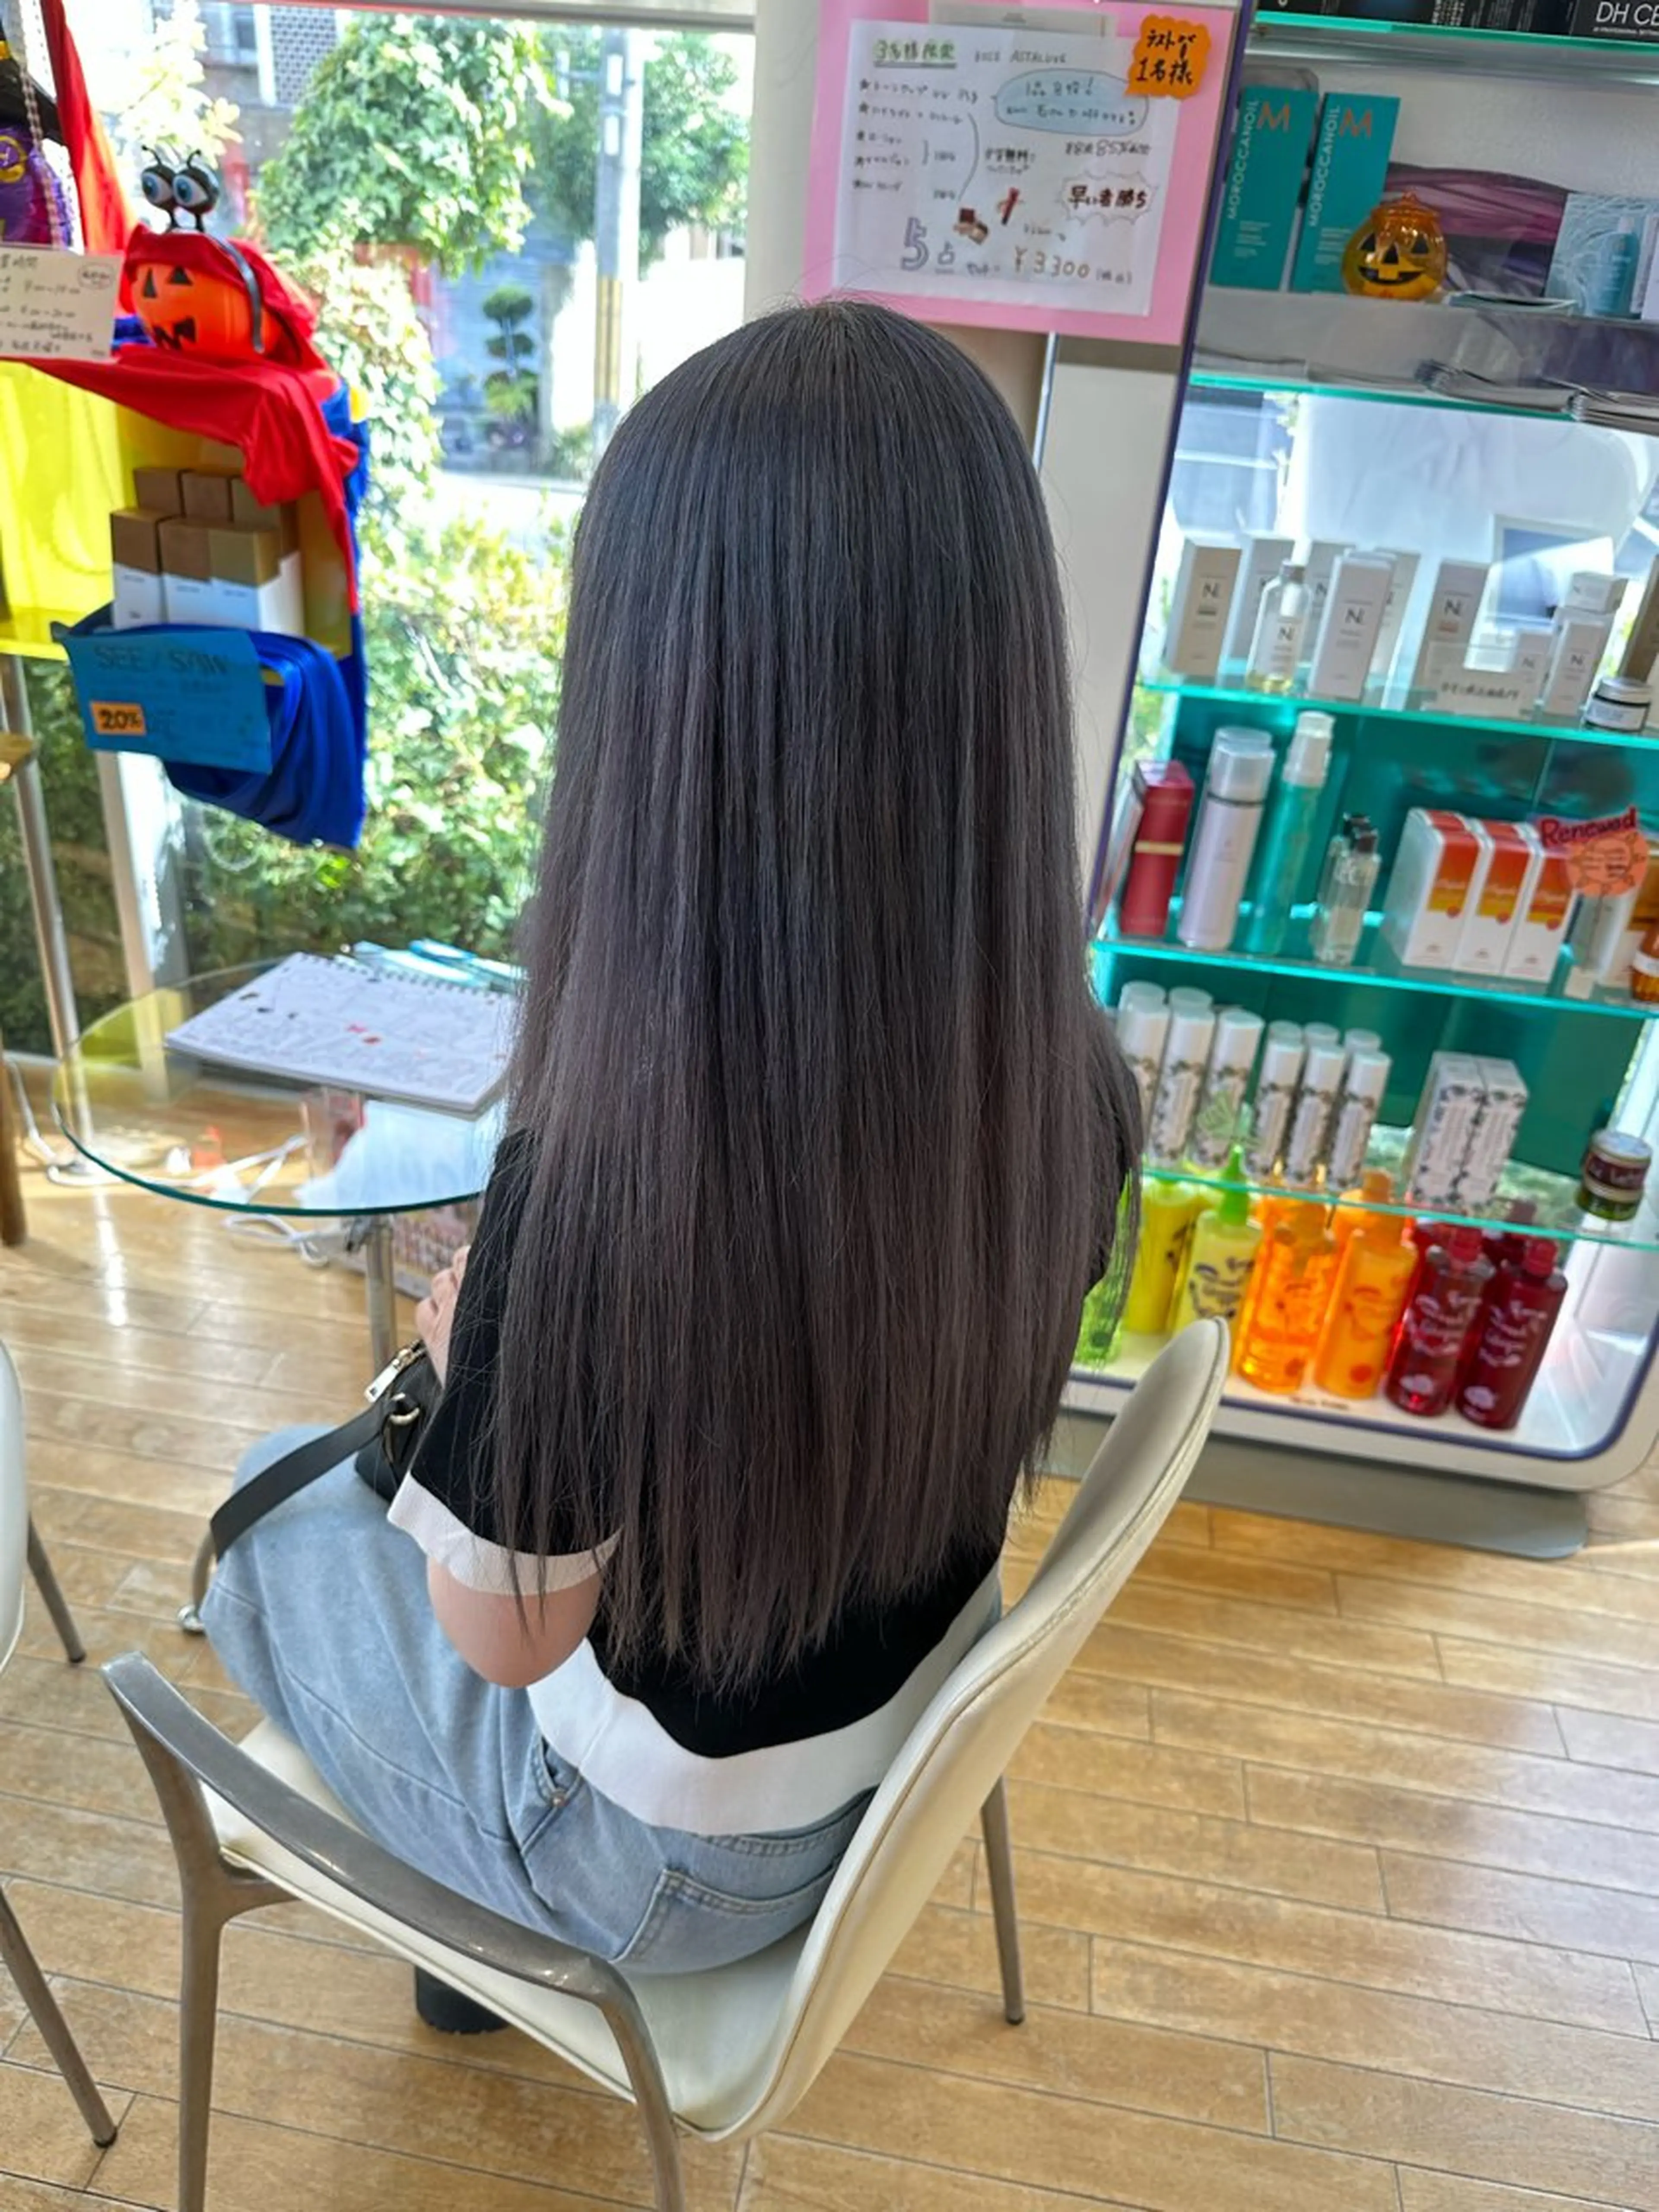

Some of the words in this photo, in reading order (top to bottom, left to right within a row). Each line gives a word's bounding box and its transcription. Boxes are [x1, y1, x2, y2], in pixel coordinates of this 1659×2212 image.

[1595, 1, 1630, 24] DH
[1256, 101, 1291, 133] M
[1338, 108, 1373, 140] M
[1227, 100, 1259, 220] MOROCCANOIL
[1308, 105, 1341, 227] MOROCCANOIL
[99, 708, 140, 730] 20%
